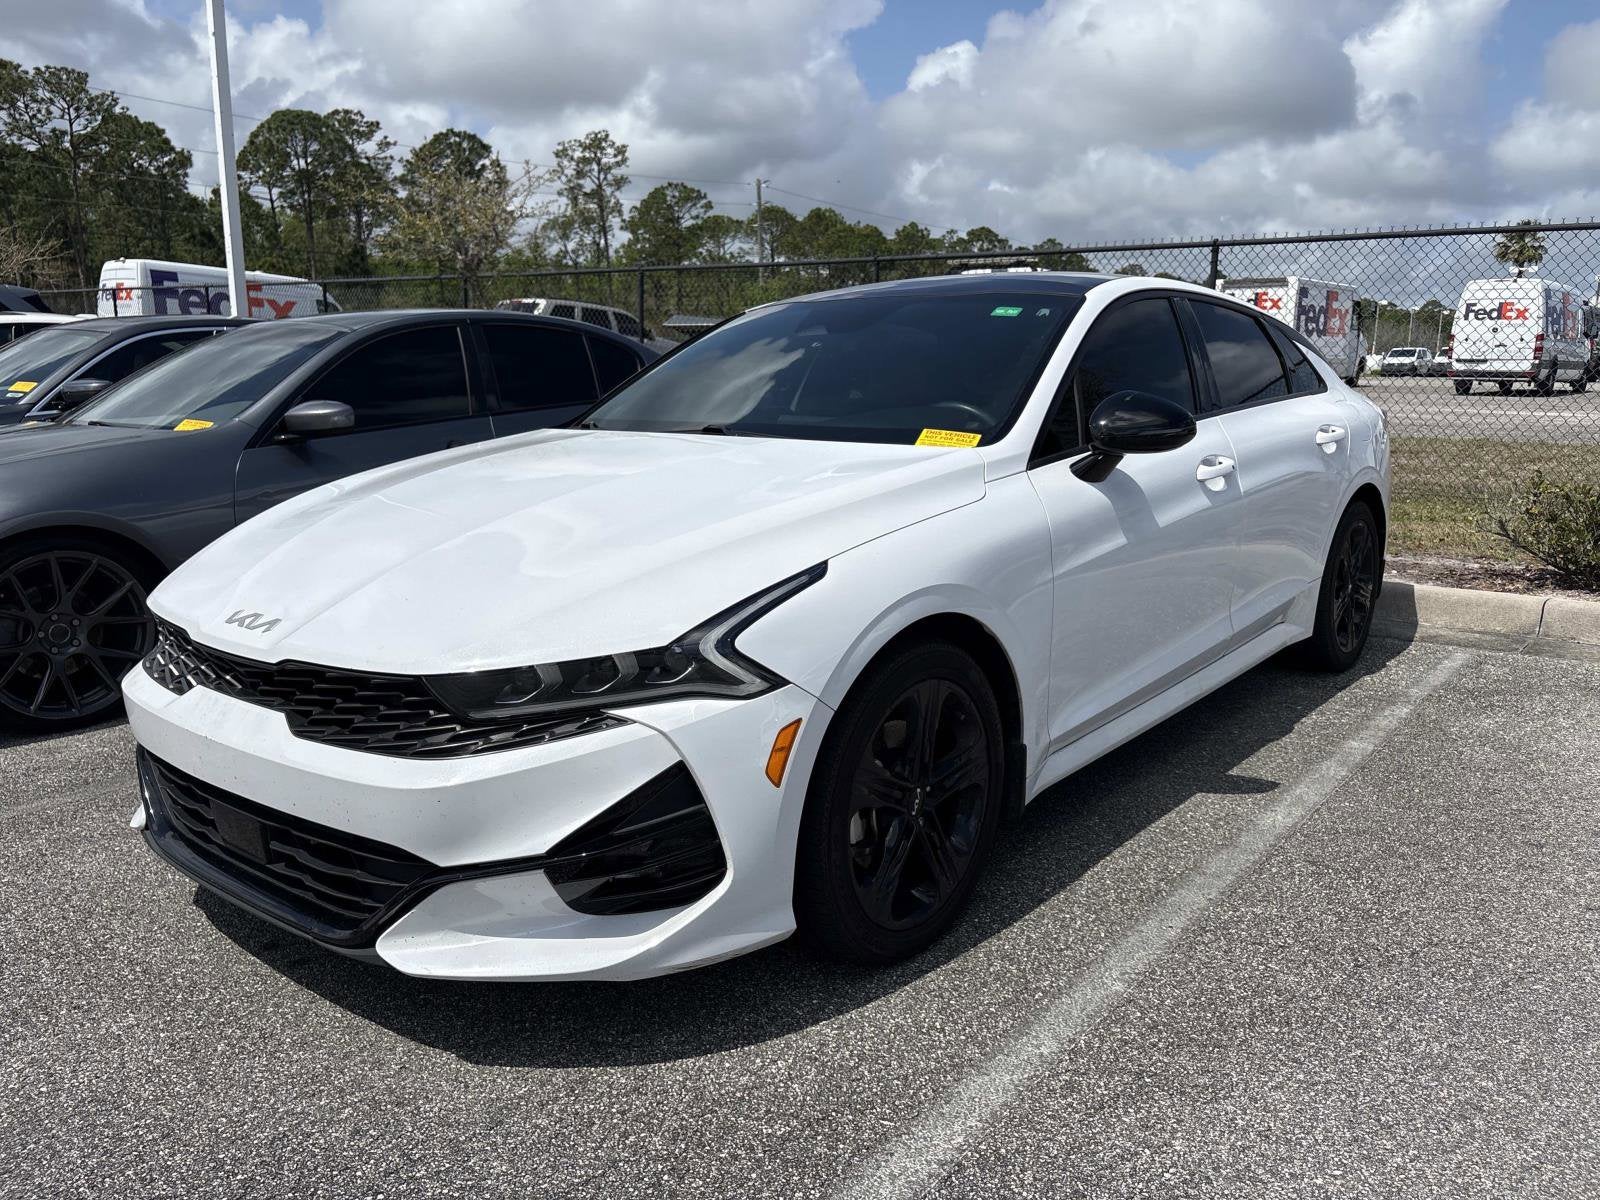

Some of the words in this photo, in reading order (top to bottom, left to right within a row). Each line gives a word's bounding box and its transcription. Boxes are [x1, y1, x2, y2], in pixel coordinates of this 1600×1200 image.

[101, 282, 133, 301] FeEx
[1297, 287, 1349, 338] FedEx
[1464, 302, 1530, 321] FedEx
[945, 431, 976, 440] VEHICLE
